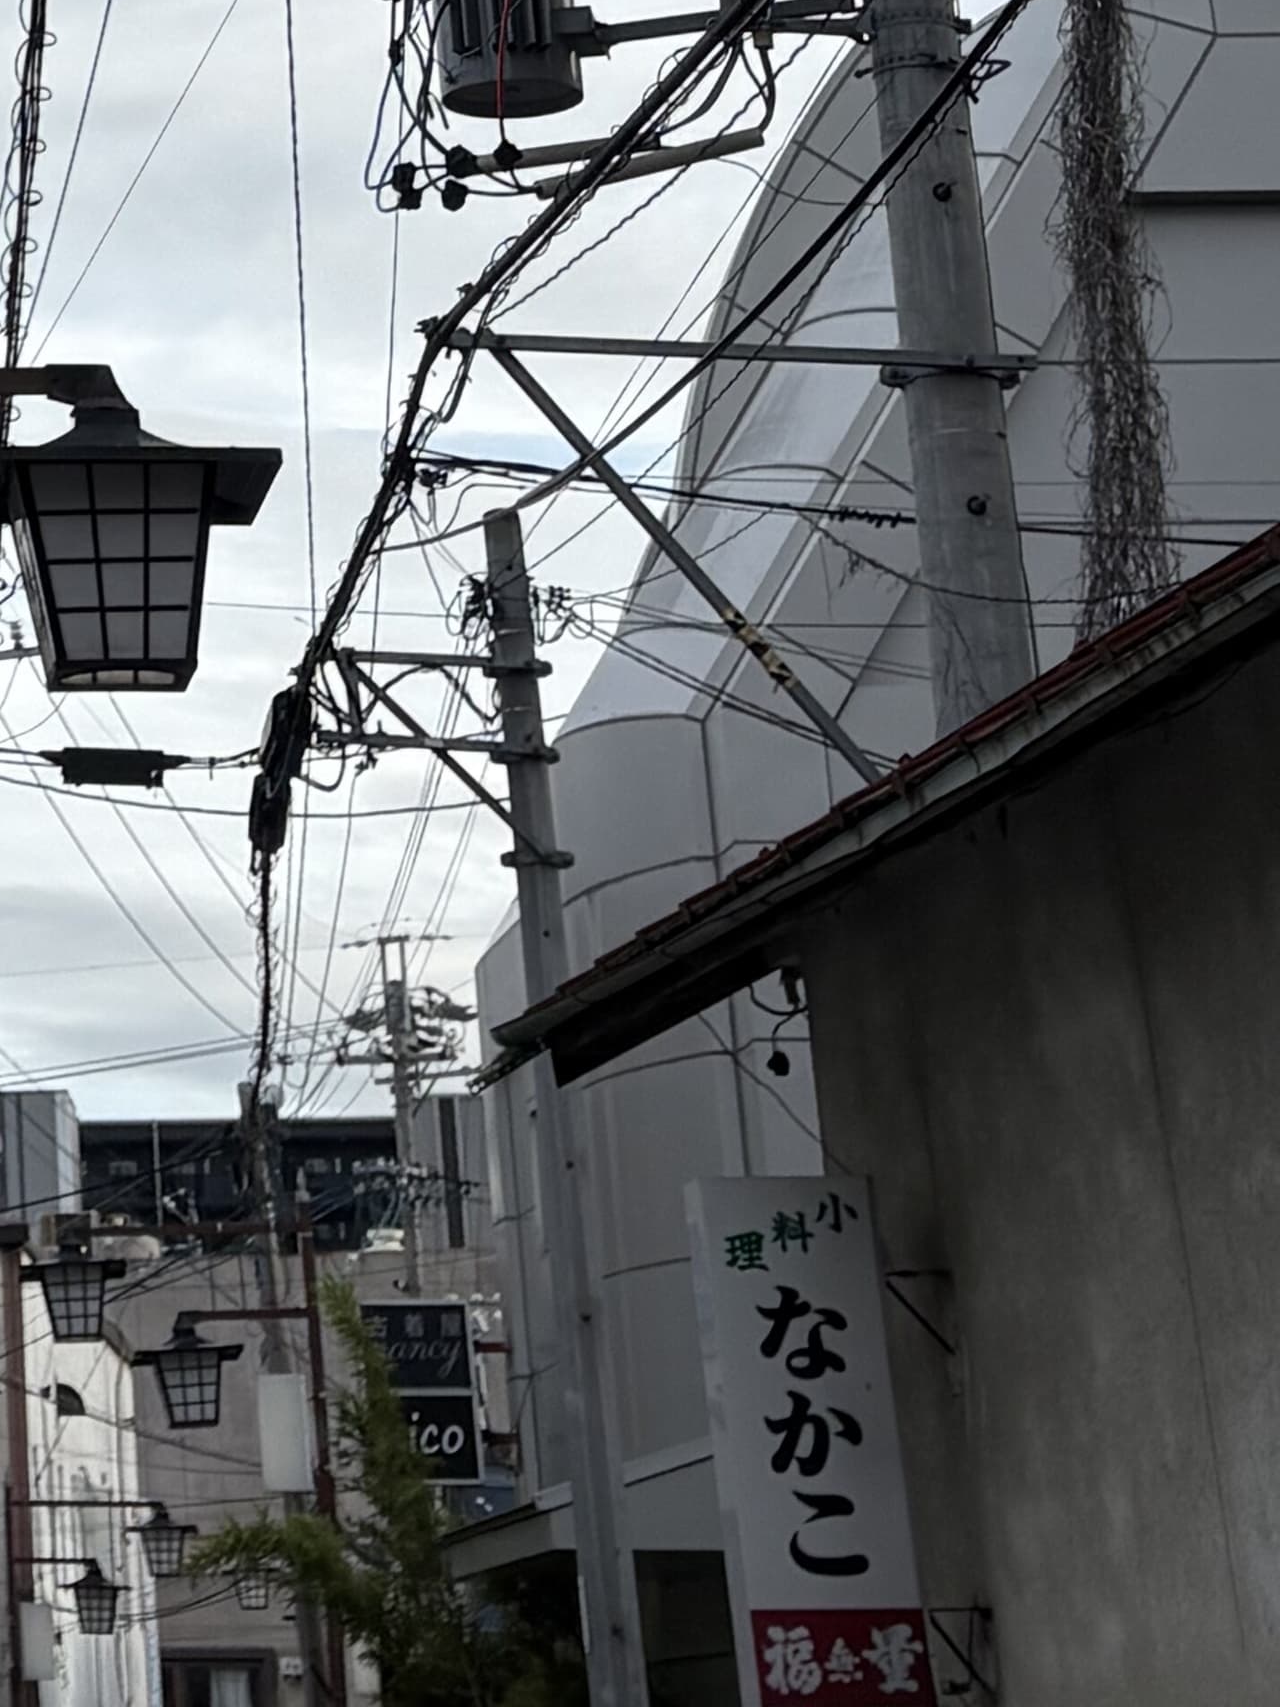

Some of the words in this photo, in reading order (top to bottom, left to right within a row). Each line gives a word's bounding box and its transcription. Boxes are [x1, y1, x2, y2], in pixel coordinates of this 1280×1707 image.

[384, 1338, 463, 1380] ancy
[755, 1285, 869, 1577] なかこ
